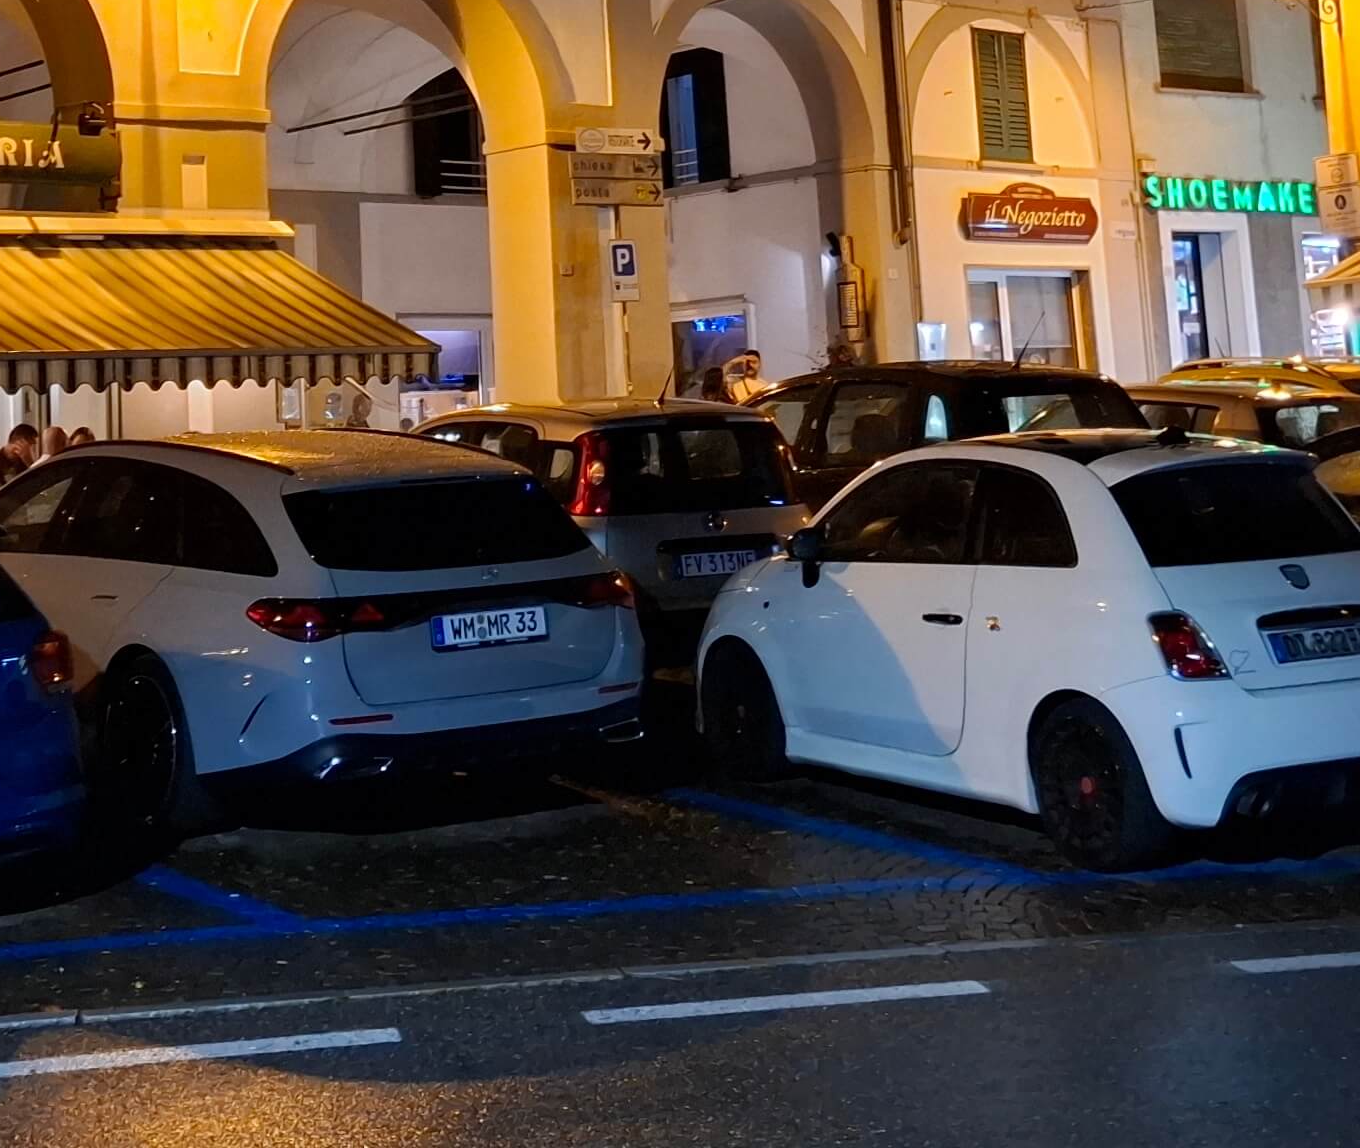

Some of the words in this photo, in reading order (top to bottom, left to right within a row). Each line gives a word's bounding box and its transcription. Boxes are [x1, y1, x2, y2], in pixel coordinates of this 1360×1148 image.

[984, 200, 1007, 224] il
[1001, 200, 1086, 235] Negozietto
[615, 248, 631, 273] P
[450, 616, 476, 641] WM
[486, 613, 512, 637] MR
[514, 611, 538, 633] 33
